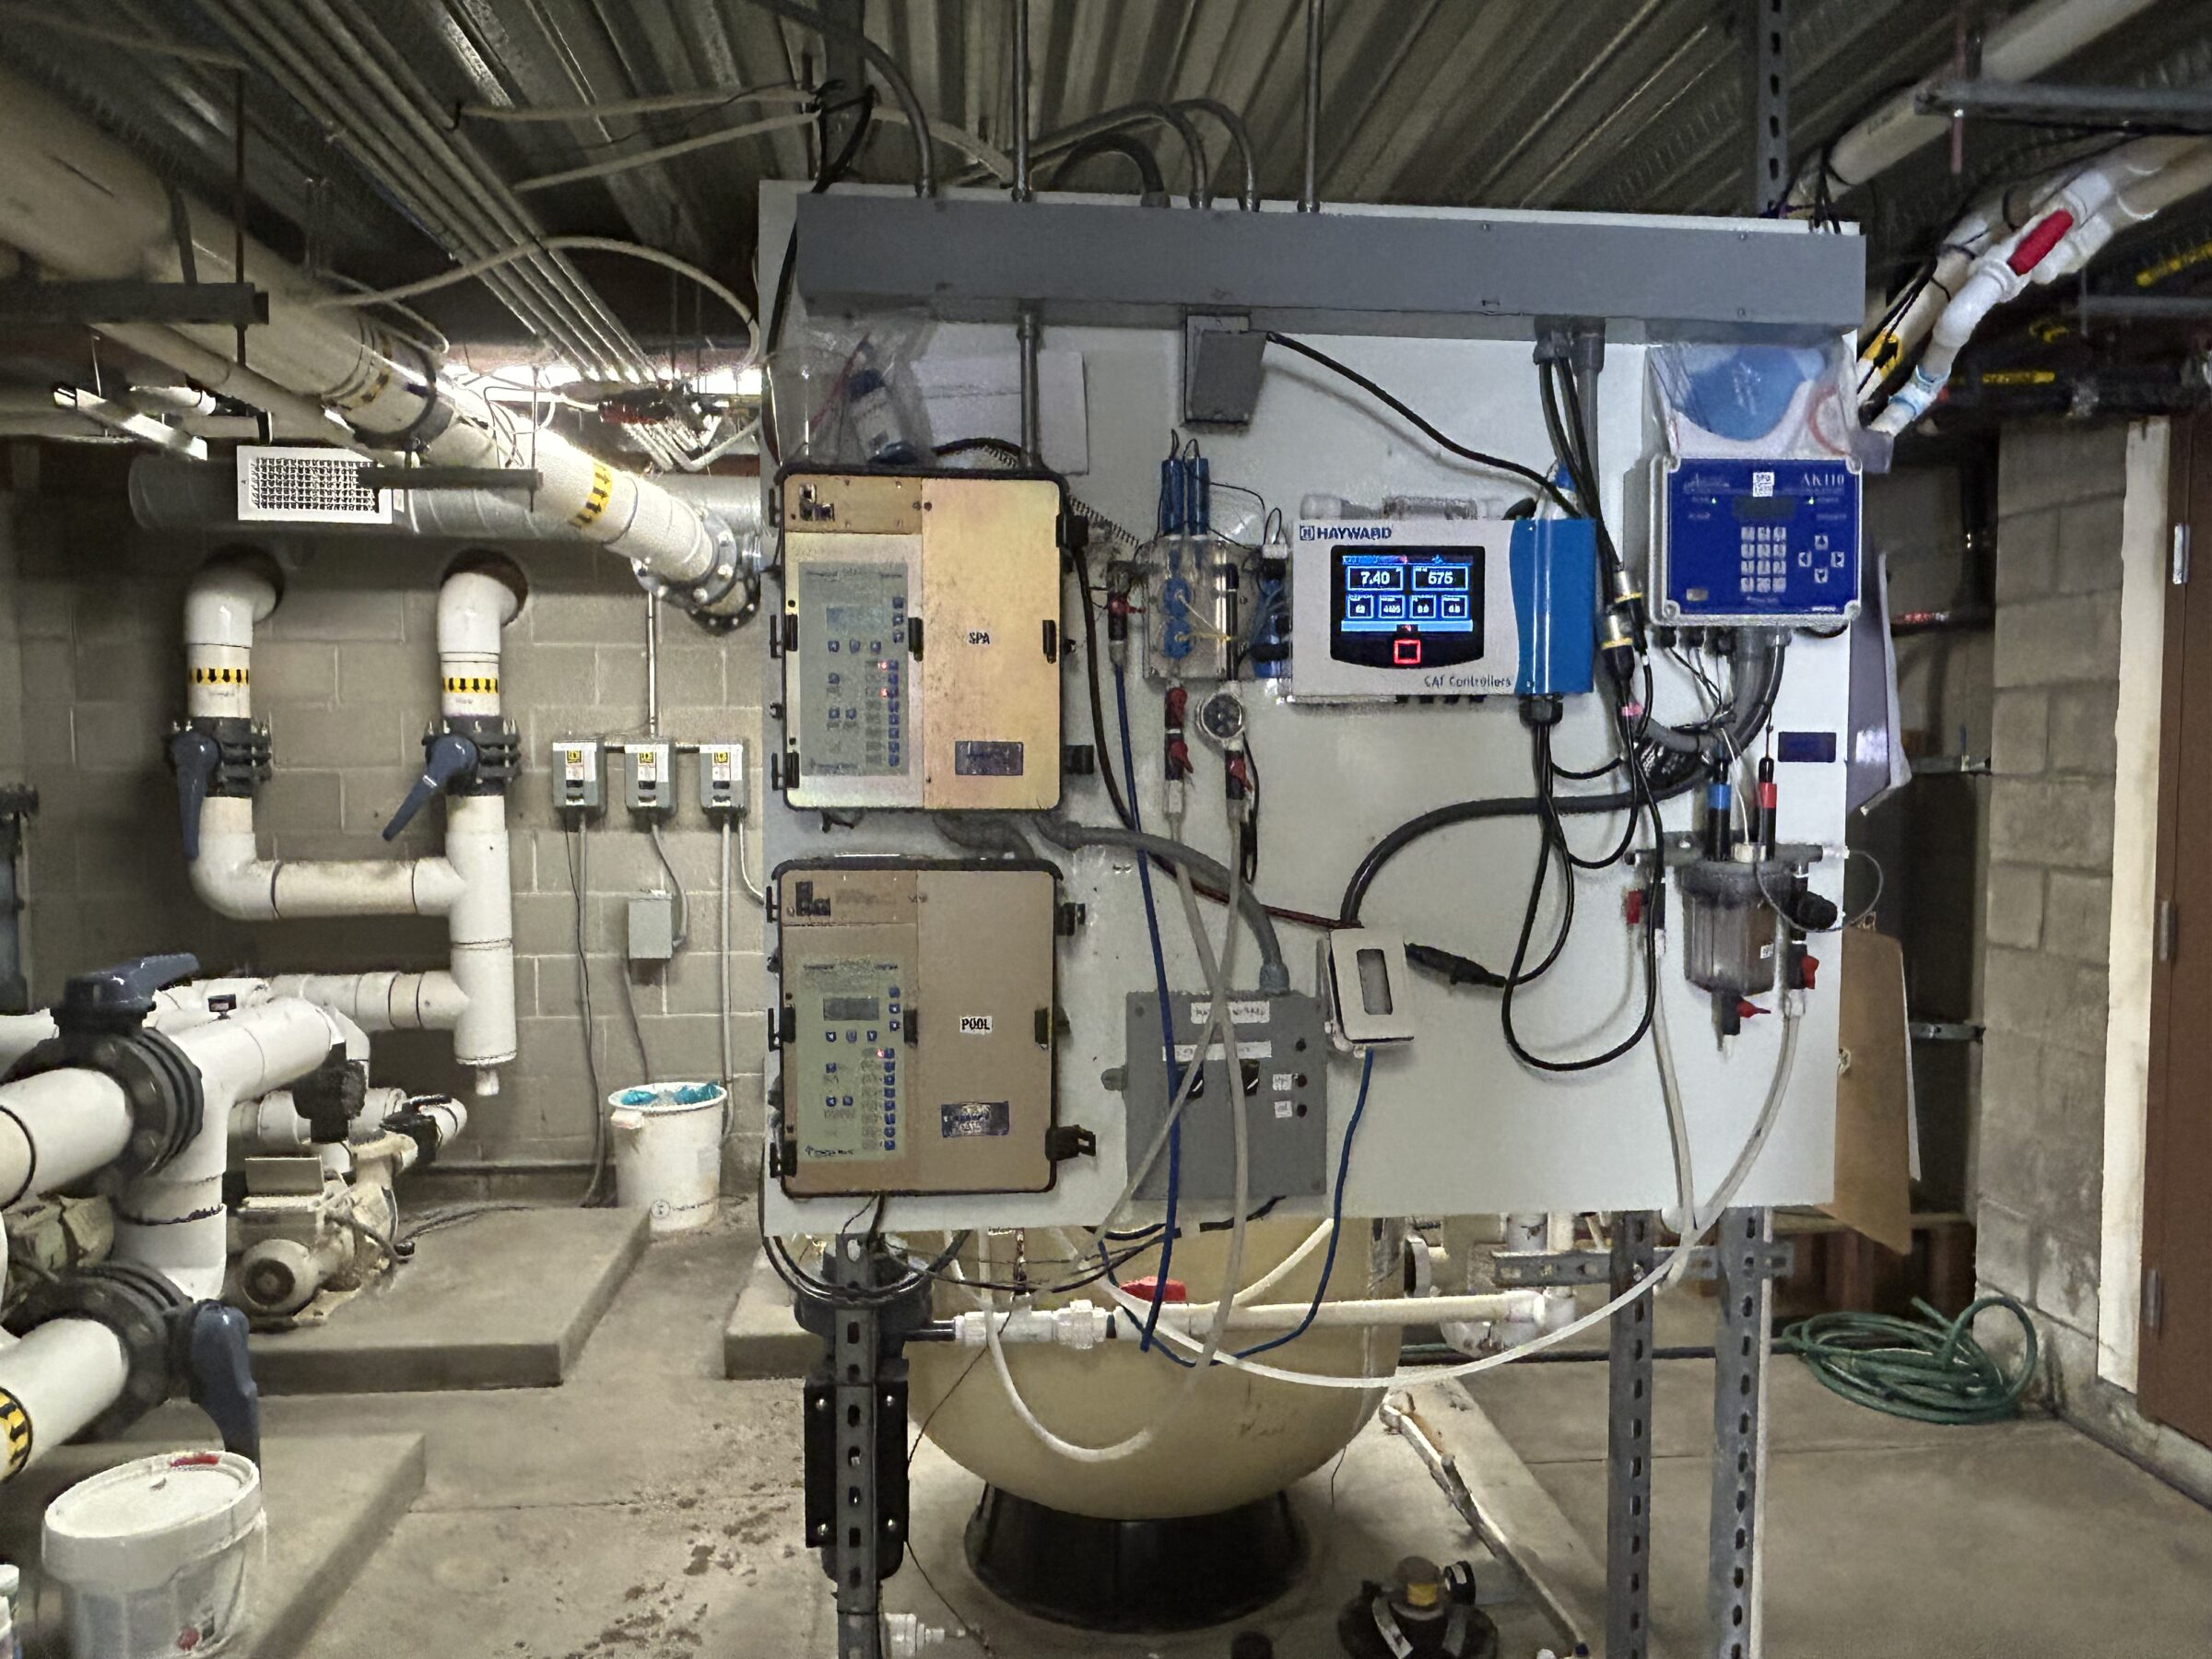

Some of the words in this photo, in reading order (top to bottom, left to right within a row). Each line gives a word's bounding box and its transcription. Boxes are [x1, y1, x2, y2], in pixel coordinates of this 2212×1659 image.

[1316, 526, 1393, 540] HAYWARD
[1360, 571, 1391, 585] 7.40
[969, 631, 991, 644] SPA
[961, 1018, 991, 1031] POOL
